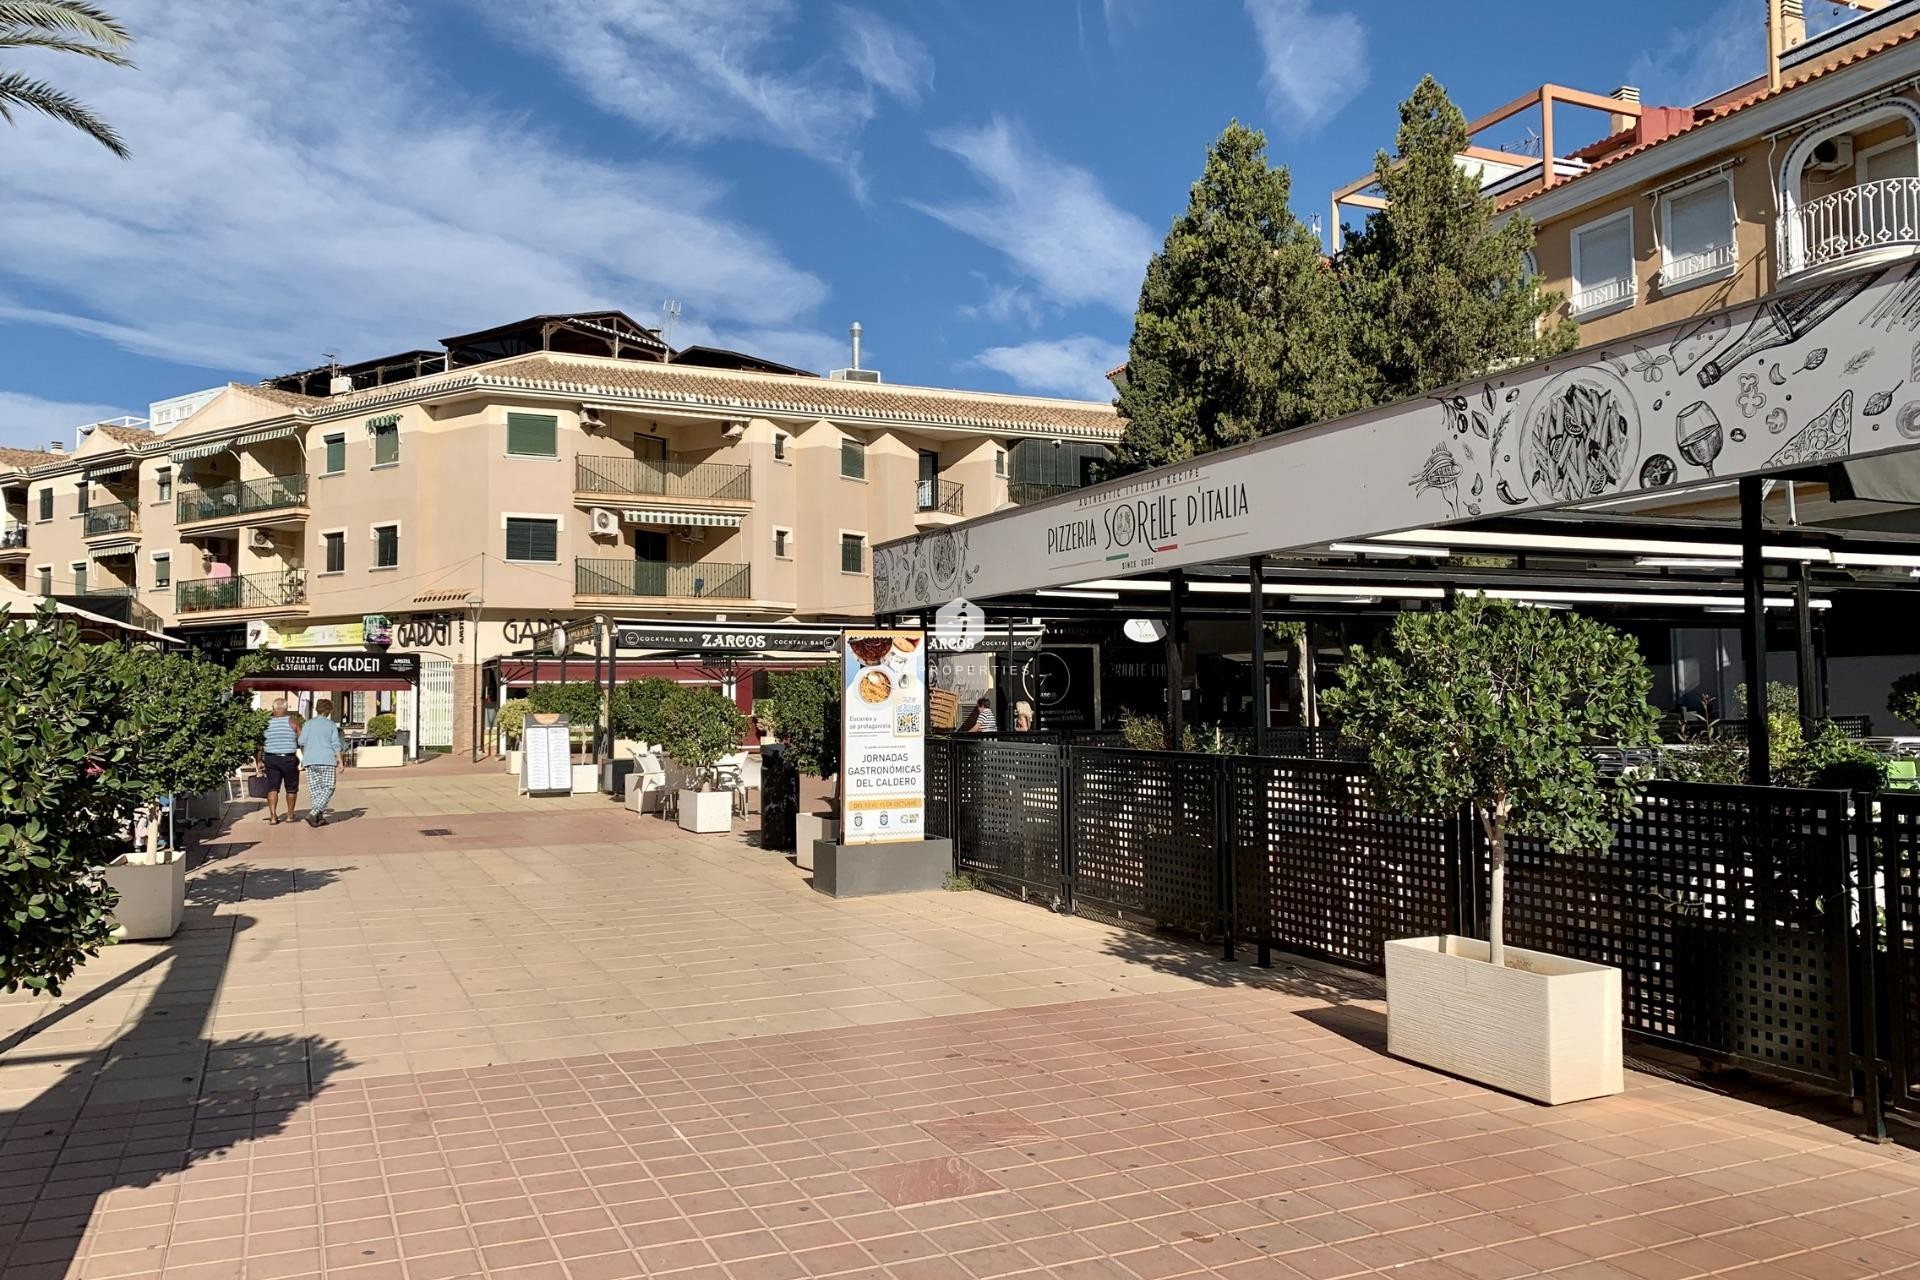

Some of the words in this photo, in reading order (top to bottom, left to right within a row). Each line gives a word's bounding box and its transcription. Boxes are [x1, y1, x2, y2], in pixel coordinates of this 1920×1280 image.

[1047, 518, 1097, 555] PIZZERIA
[1187, 482, 1249, 526] D'ITALIA
[1122, 560, 1137, 570] SINCE
[701, 634, 766, 648] ZARCOS
[927, 637, 975, 650] ARCOS
[285, 655, 316, 664] PIZZERIA
[328, 657, 380, 672] GARDEN
[861, 753, 909, 763] JORNADAS
[848, 764, 922, 776] GASTRONÓMICAS
[856, 779, 873, 788] DEL
[876, 777, 916, 787] CALDERO
